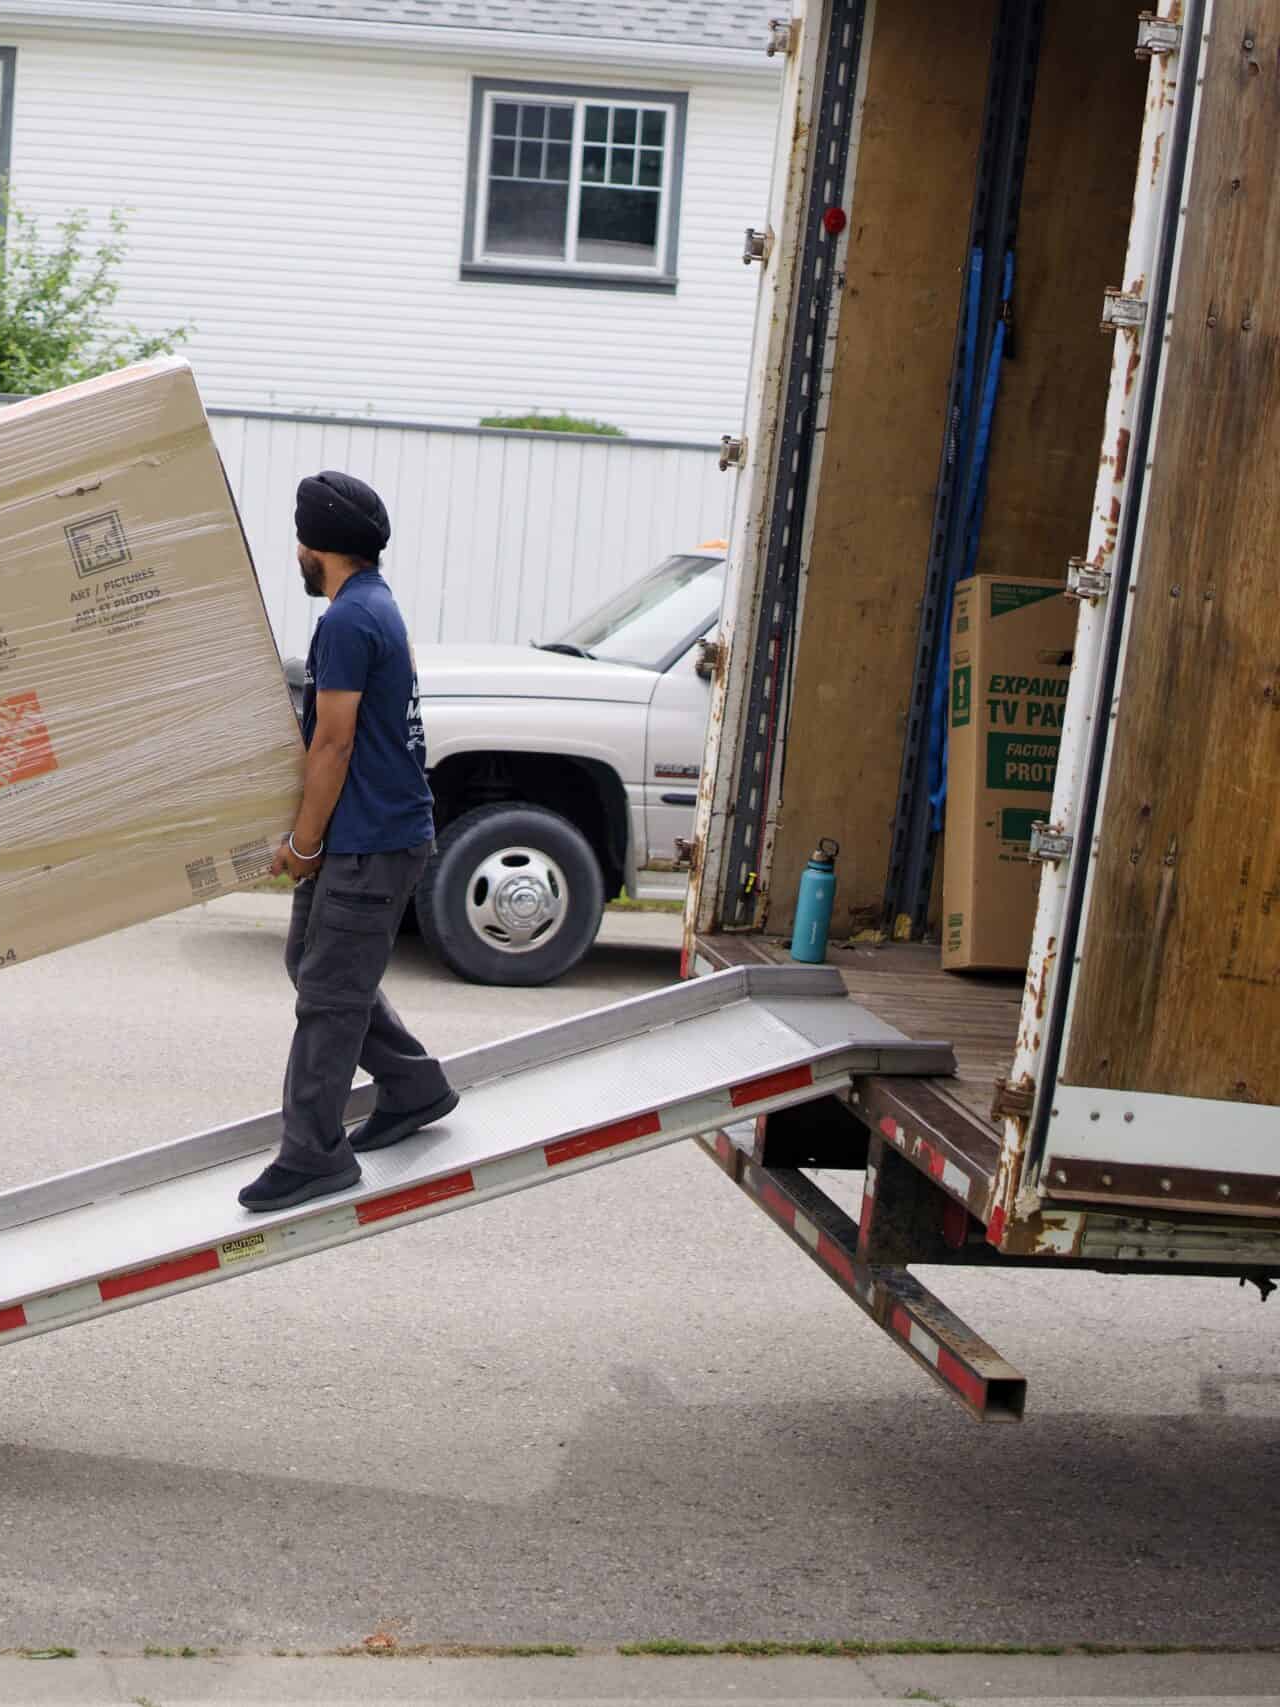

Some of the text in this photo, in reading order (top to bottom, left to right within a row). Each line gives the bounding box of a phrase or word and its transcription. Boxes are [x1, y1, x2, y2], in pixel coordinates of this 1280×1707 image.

[69, 586, 91, 603] ART
[986, 699, 1019, 726] TV
[1006, 743, 1057, 758] FACTOR
[1005, 762, 1057, 783] PROT
[223, 1232, 265, 1253] CAUTION
